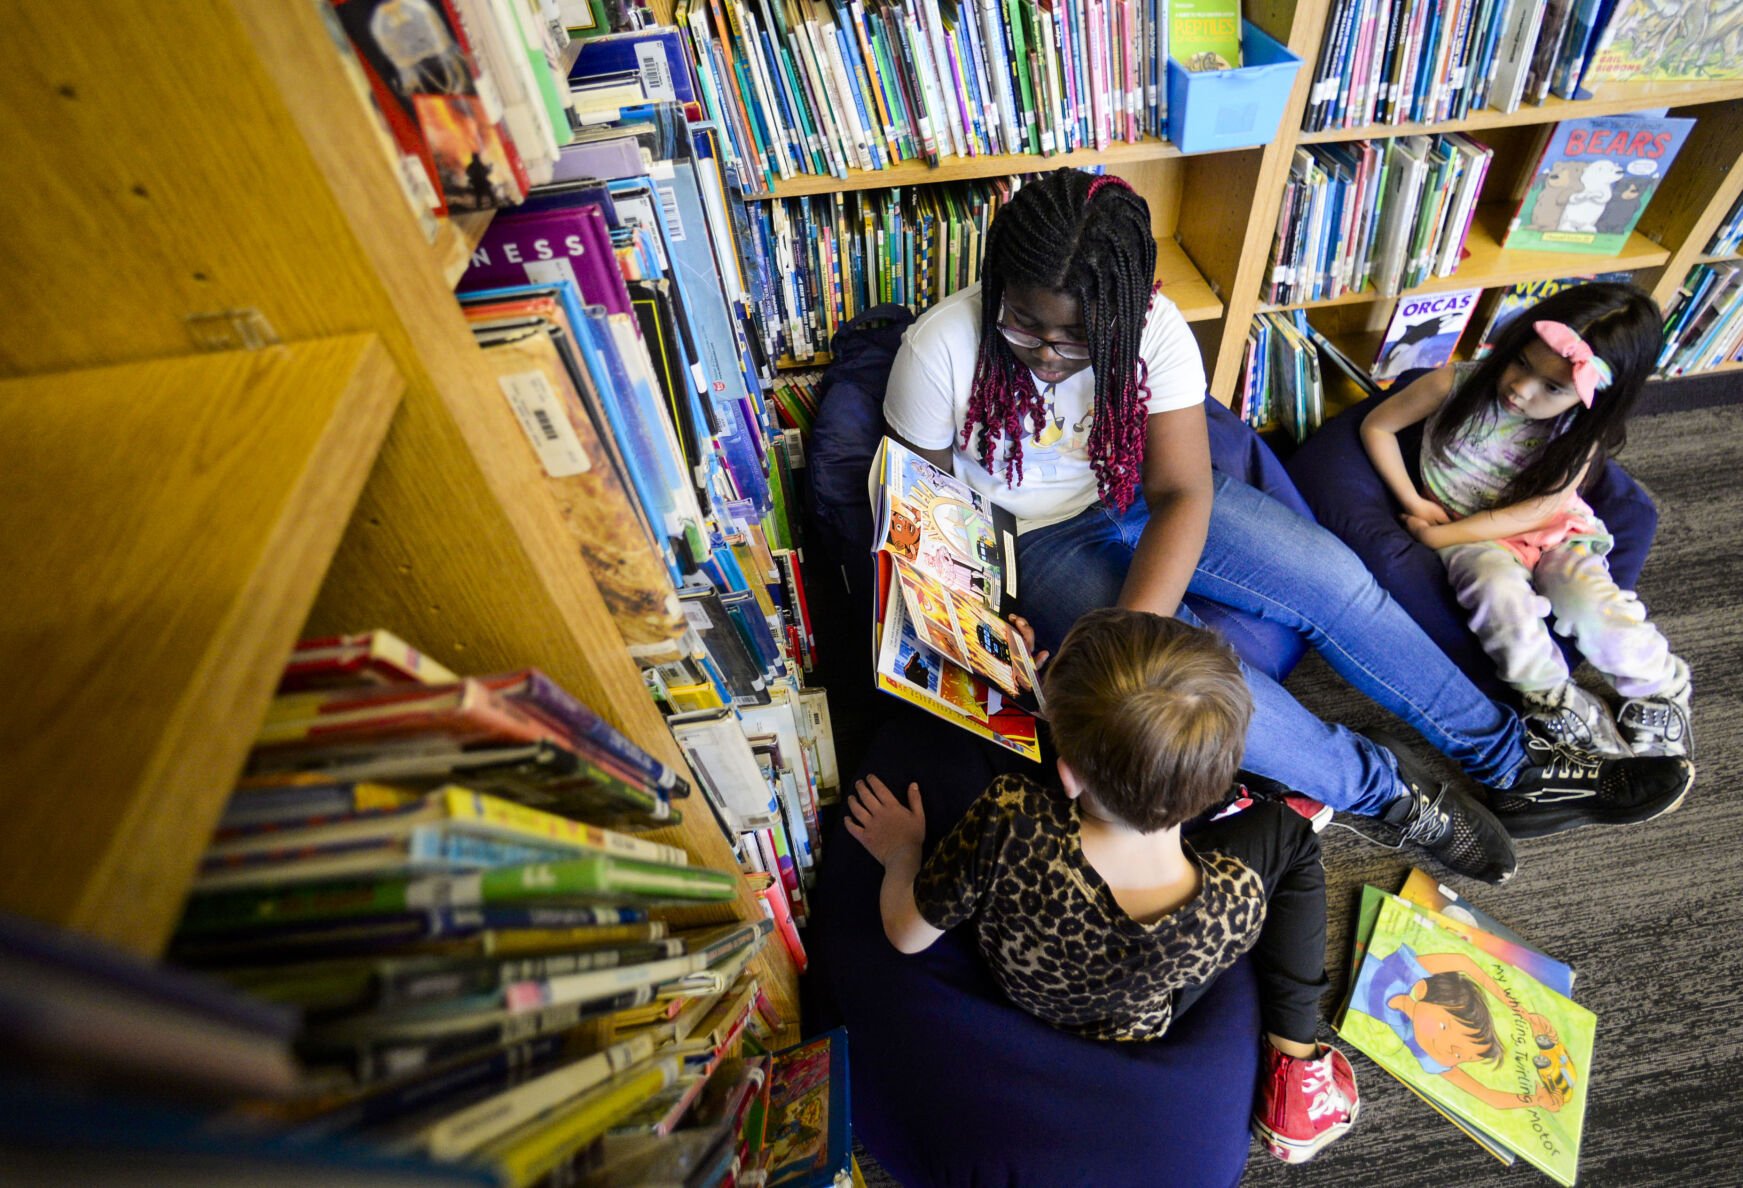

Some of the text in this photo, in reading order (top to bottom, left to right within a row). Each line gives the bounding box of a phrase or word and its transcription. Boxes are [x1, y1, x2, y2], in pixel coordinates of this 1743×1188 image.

[1174, 17, 1236, 36] REPTILES
[1596, 64, 1641, 72] GIBBONS
[1564, 129, 1672, 158] BEARS
[1402, 295, 1473, 316] ORCAS
[1491, 963, 1508, 982] My
[1514, 1050, 1533, 1104] Twirling
[1527, 1109, 1561, 1157] Motor
